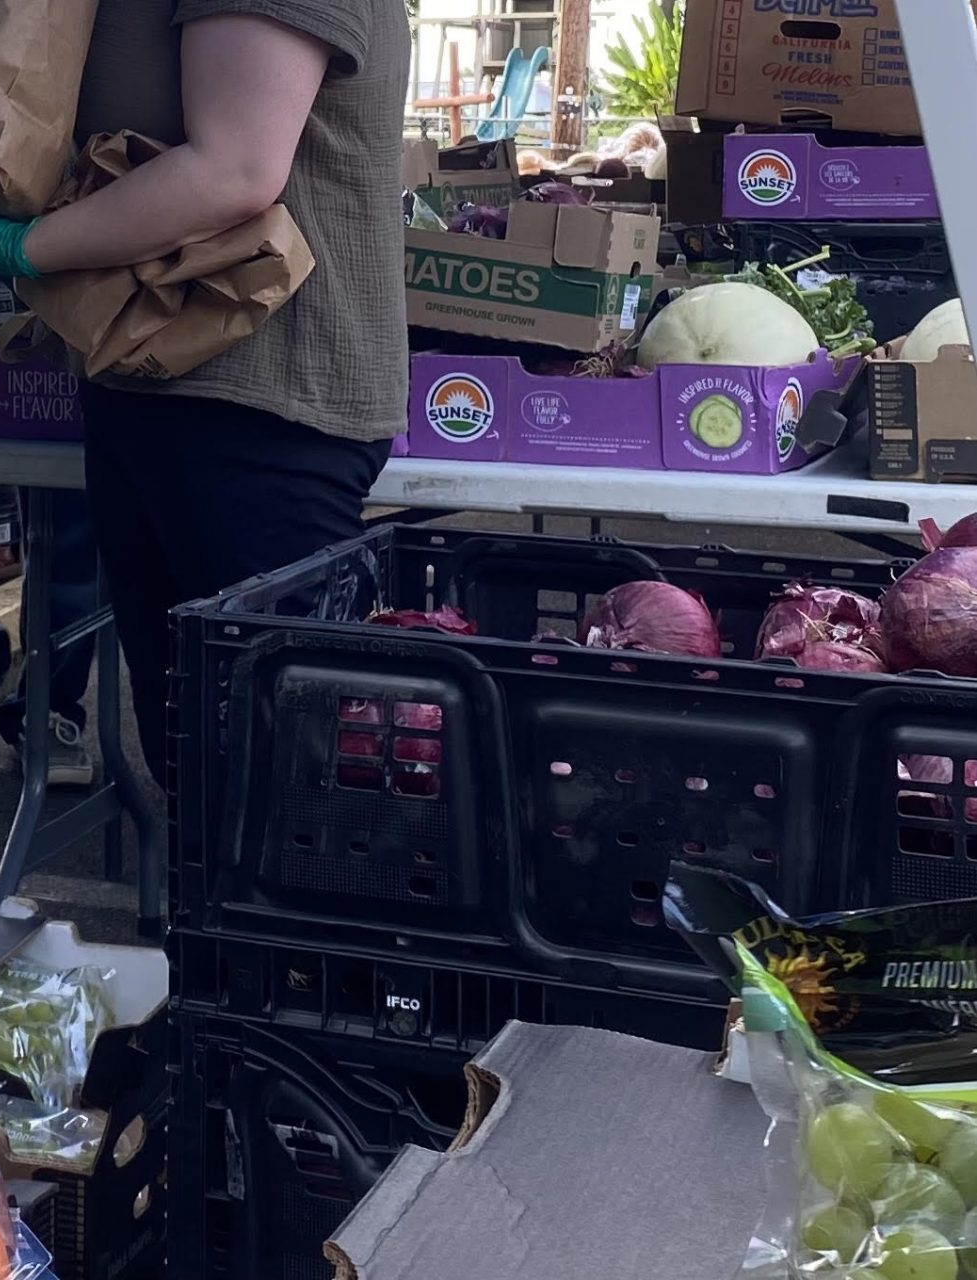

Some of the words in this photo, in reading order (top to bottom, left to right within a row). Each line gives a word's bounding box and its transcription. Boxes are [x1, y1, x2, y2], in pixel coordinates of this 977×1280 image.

[772, 35, 852, 51] CALIFORNIA
[787, 51, 832, 65] FRESH
[762, 63, 852, 87] Melons
[740, 177, 794, 193] SUNSET
[405, 252, 540, 302] ATOES
[425, 301, 494, 322] GREENHOUSE
[496, 313, 536, 328] GROWN
[7, 370, 79, 397] INSPIRED
[678, 378, 714, 404] INSPIRED
[723, 379, 754, 405] FLAVOR
[13, 395, 74, 422] FLAVOR
[428, 407, 492, 424] SUNSET
[881, 960, 977, 990] PREMIUM
[386, 995, 420, 1011] IFCO
